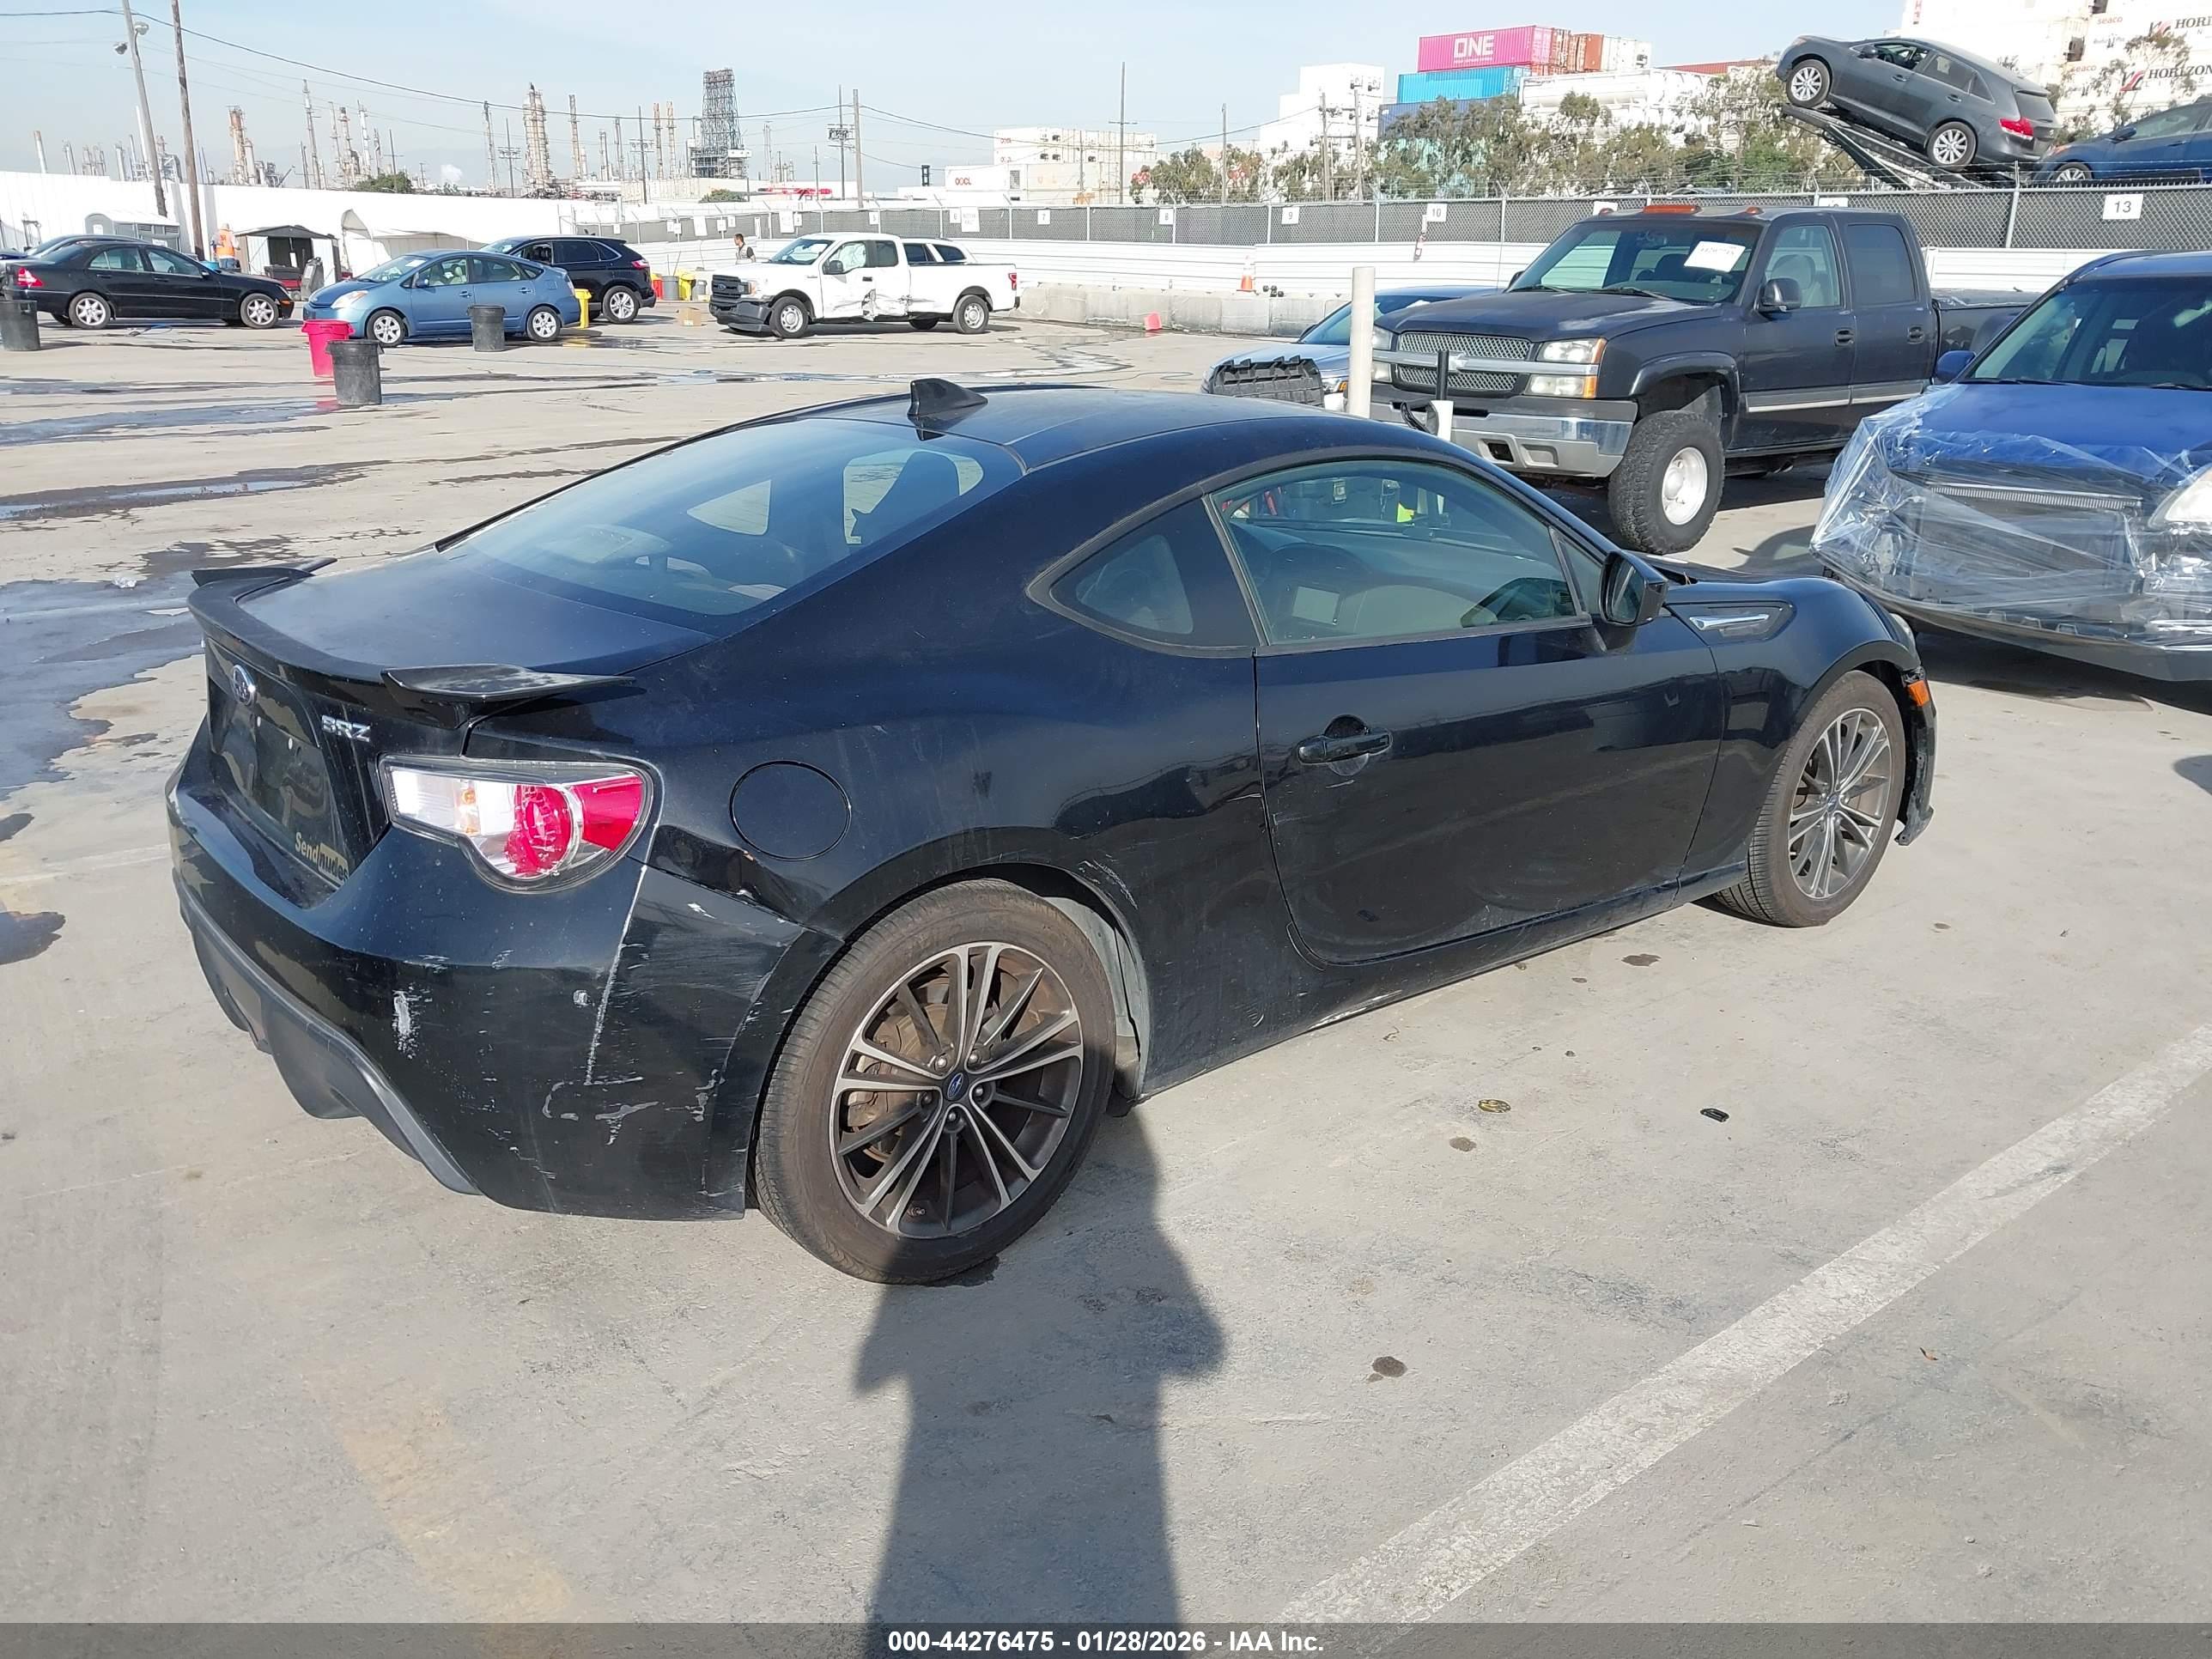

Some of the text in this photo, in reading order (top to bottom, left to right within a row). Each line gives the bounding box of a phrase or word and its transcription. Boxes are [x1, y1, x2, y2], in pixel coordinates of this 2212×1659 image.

[1454, 35, 1494, 58] ONE
[1431, 208, 1442, 218] 10
[2115, 200, 2131, 213] 13
[321, 714, 371, 742] BRZ
[295, 831, 349, 881] Send nudes
